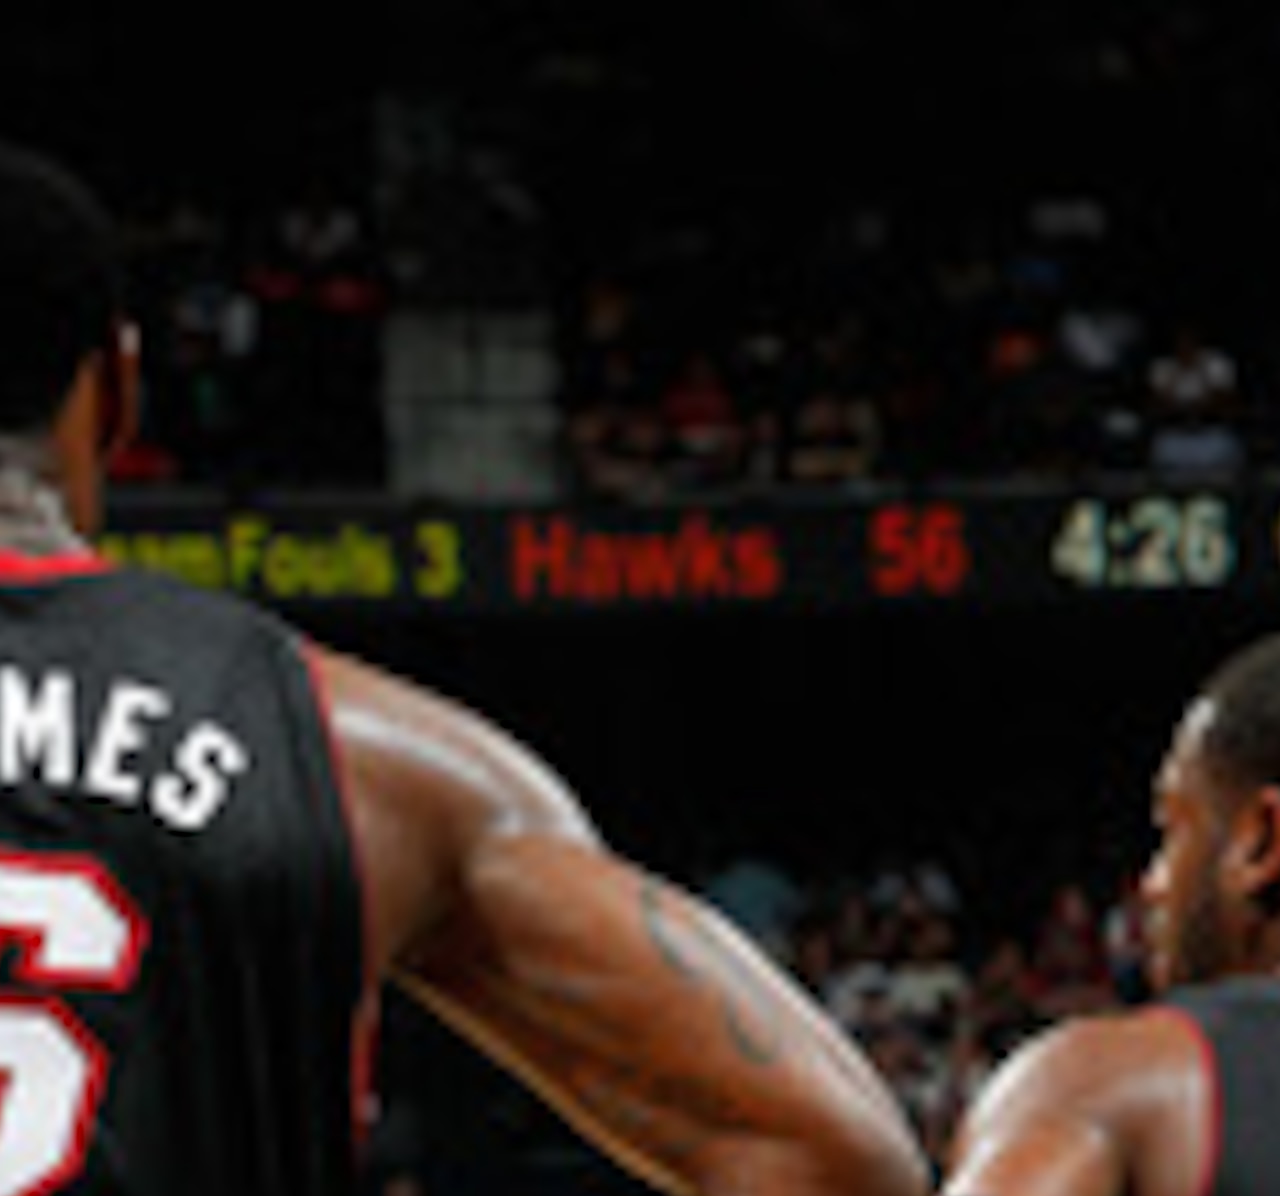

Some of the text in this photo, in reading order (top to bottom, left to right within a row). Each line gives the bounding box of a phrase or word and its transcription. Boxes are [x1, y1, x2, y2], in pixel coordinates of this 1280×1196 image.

[414, 520, 460, 596] 3
[510, 510, 966, 600] Hawks 56
[1050, 498, 1232, 588] 4:26
